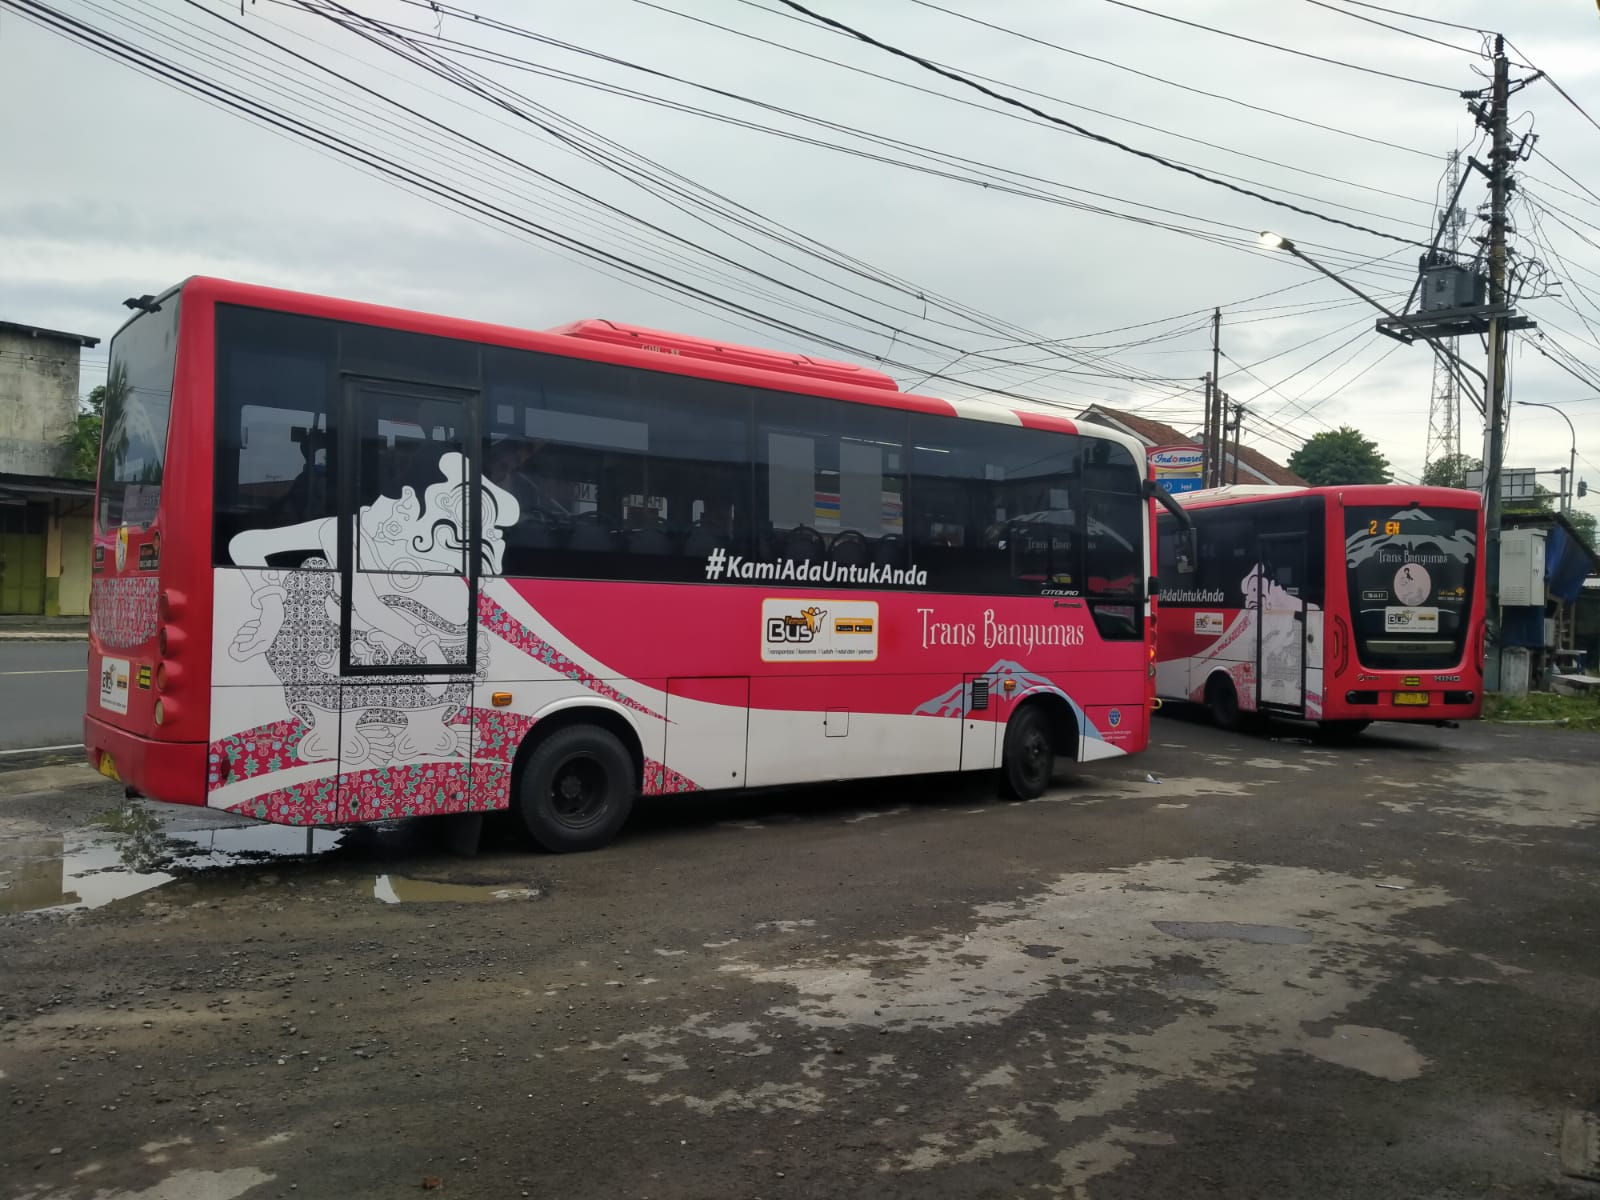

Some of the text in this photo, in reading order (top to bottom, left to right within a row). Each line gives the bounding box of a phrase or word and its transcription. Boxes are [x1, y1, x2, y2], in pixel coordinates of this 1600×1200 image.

[1369, 520, 1378, 535] 2
[1378, 549, 1448, 566] Trans Banyumas
[705, 547, 928, 586] #KamiAdaUntukAnda
[917, 608, 1084, 656] Trans Banyumas
[1433, 674, 1461, 683] HINO
